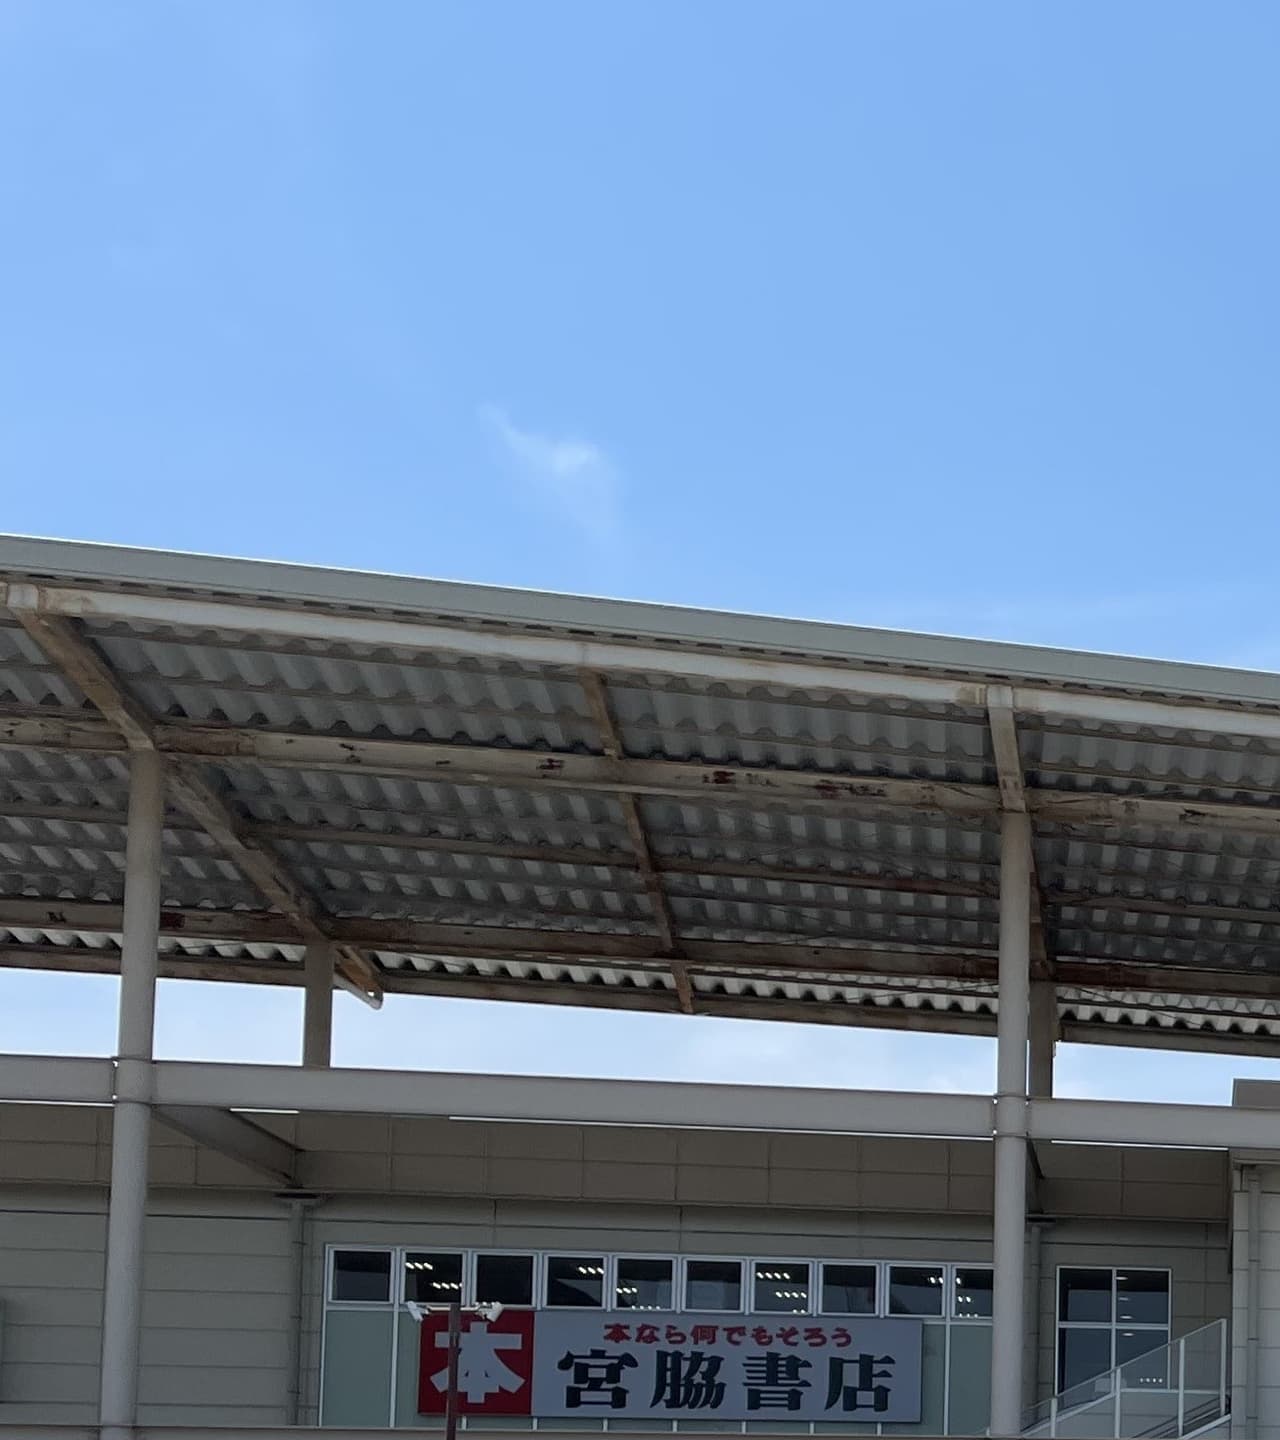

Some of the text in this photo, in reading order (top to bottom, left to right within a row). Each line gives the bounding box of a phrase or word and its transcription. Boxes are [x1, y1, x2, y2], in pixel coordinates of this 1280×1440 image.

[429, 1321, 526, 1404] 本
[603, 1323, 853, 1347] 本なら何でもそろう
[557, 1348, 897, 1413] 宮脇書店
